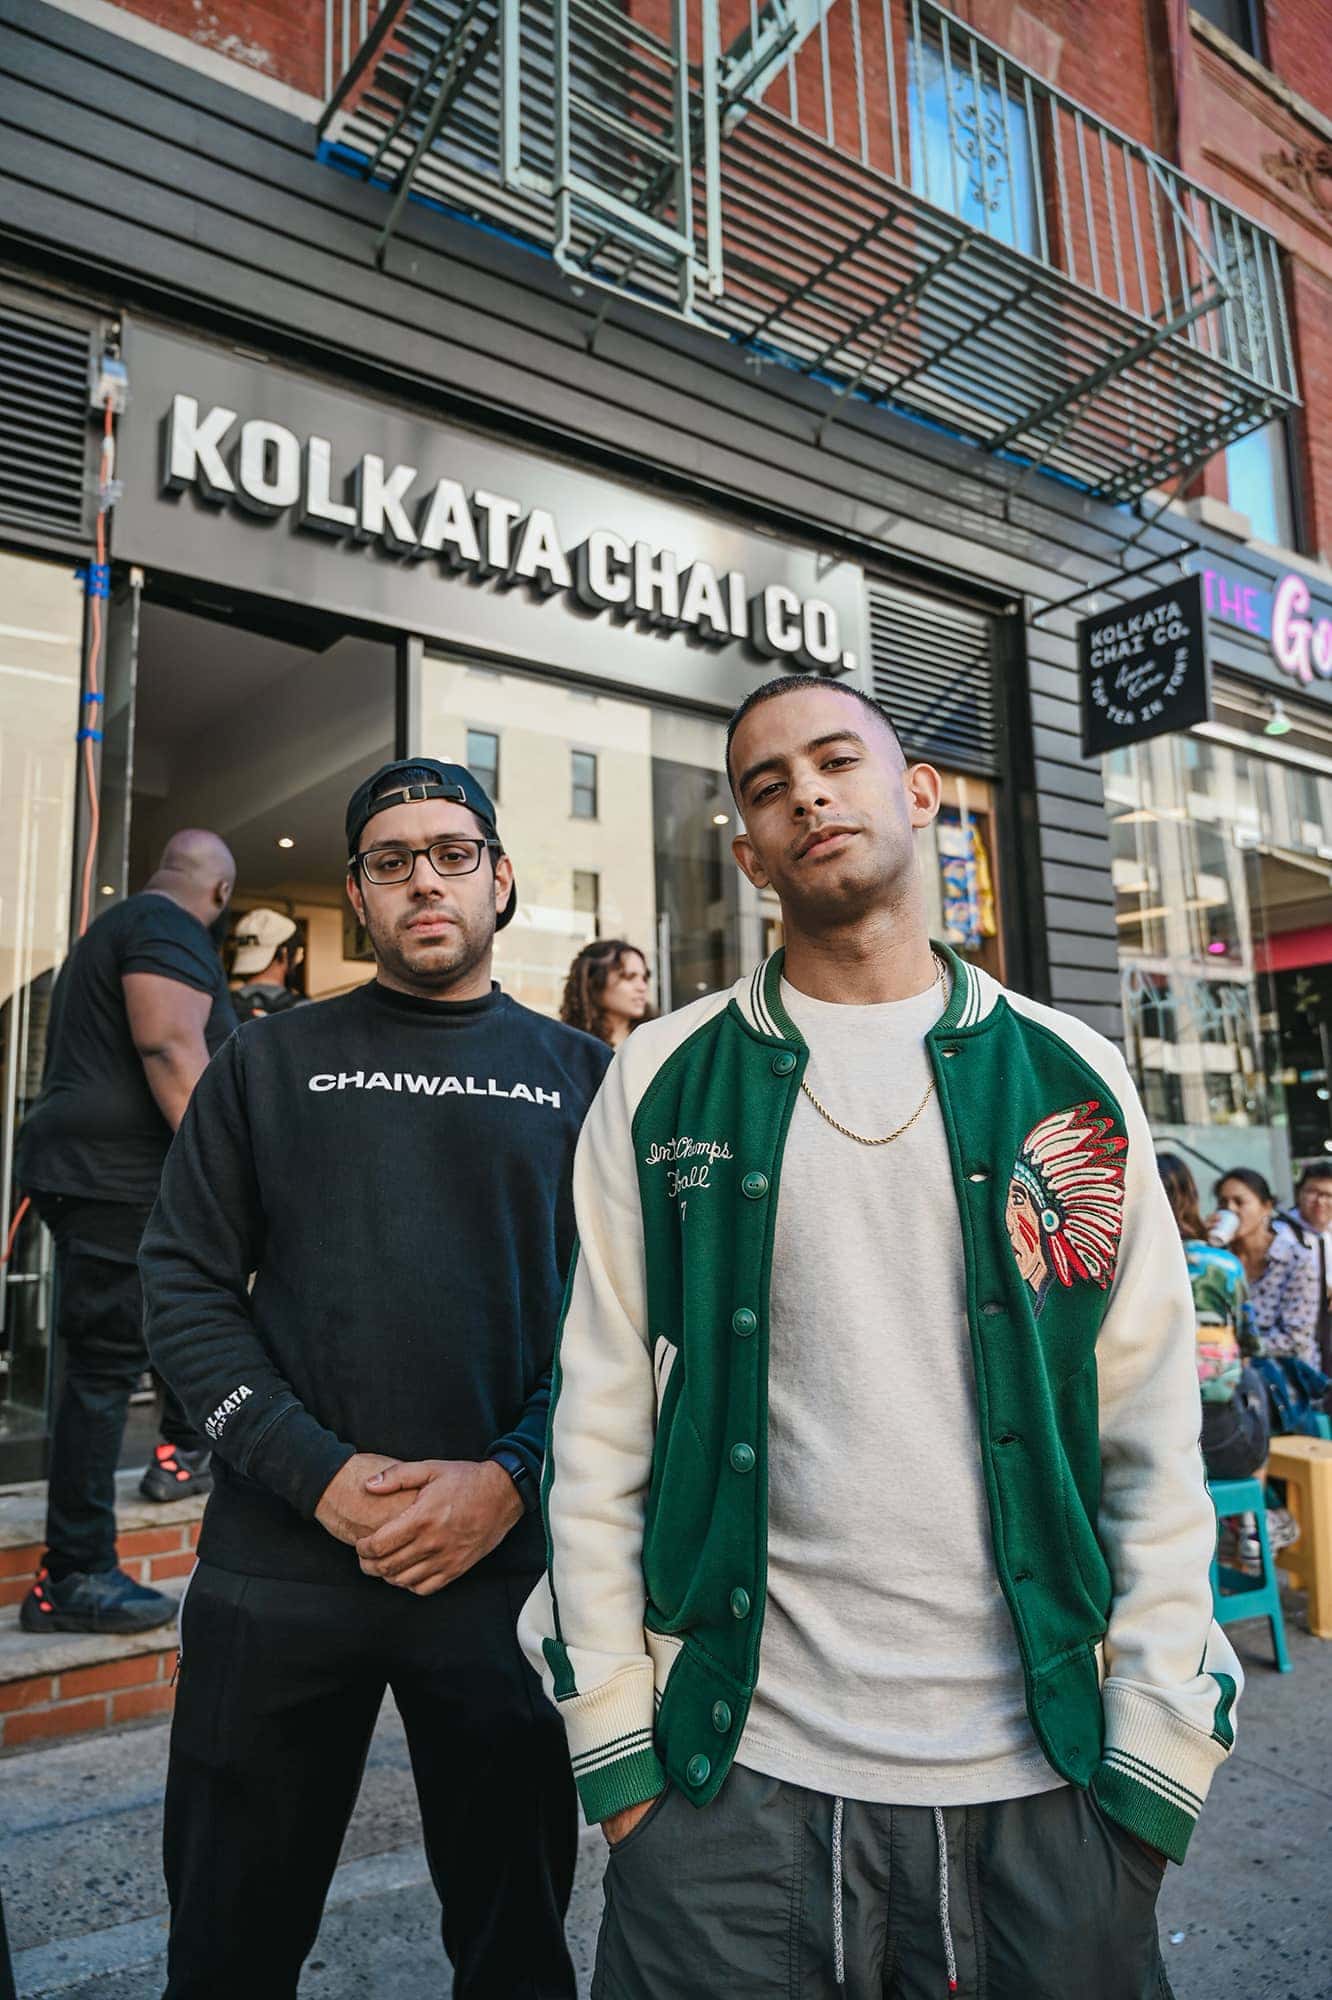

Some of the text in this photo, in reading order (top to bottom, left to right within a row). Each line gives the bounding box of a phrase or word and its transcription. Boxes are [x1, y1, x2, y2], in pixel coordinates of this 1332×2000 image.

[166, 395, 858, 671] KOLKATA CHAI CO.
[1090, 601, 1182, 650] KOLKATA
[1202, 568, 1262, 633] THE
[1090, 620, 1190, 669] CHAI CO.
[1106, 704, 1136, 725] TEA
[1140, 698, 1164, 722] IN
[1162, 646, 1189, 696] TOWN
[308, 1071, 561, 1108] CHAIWALLAH
